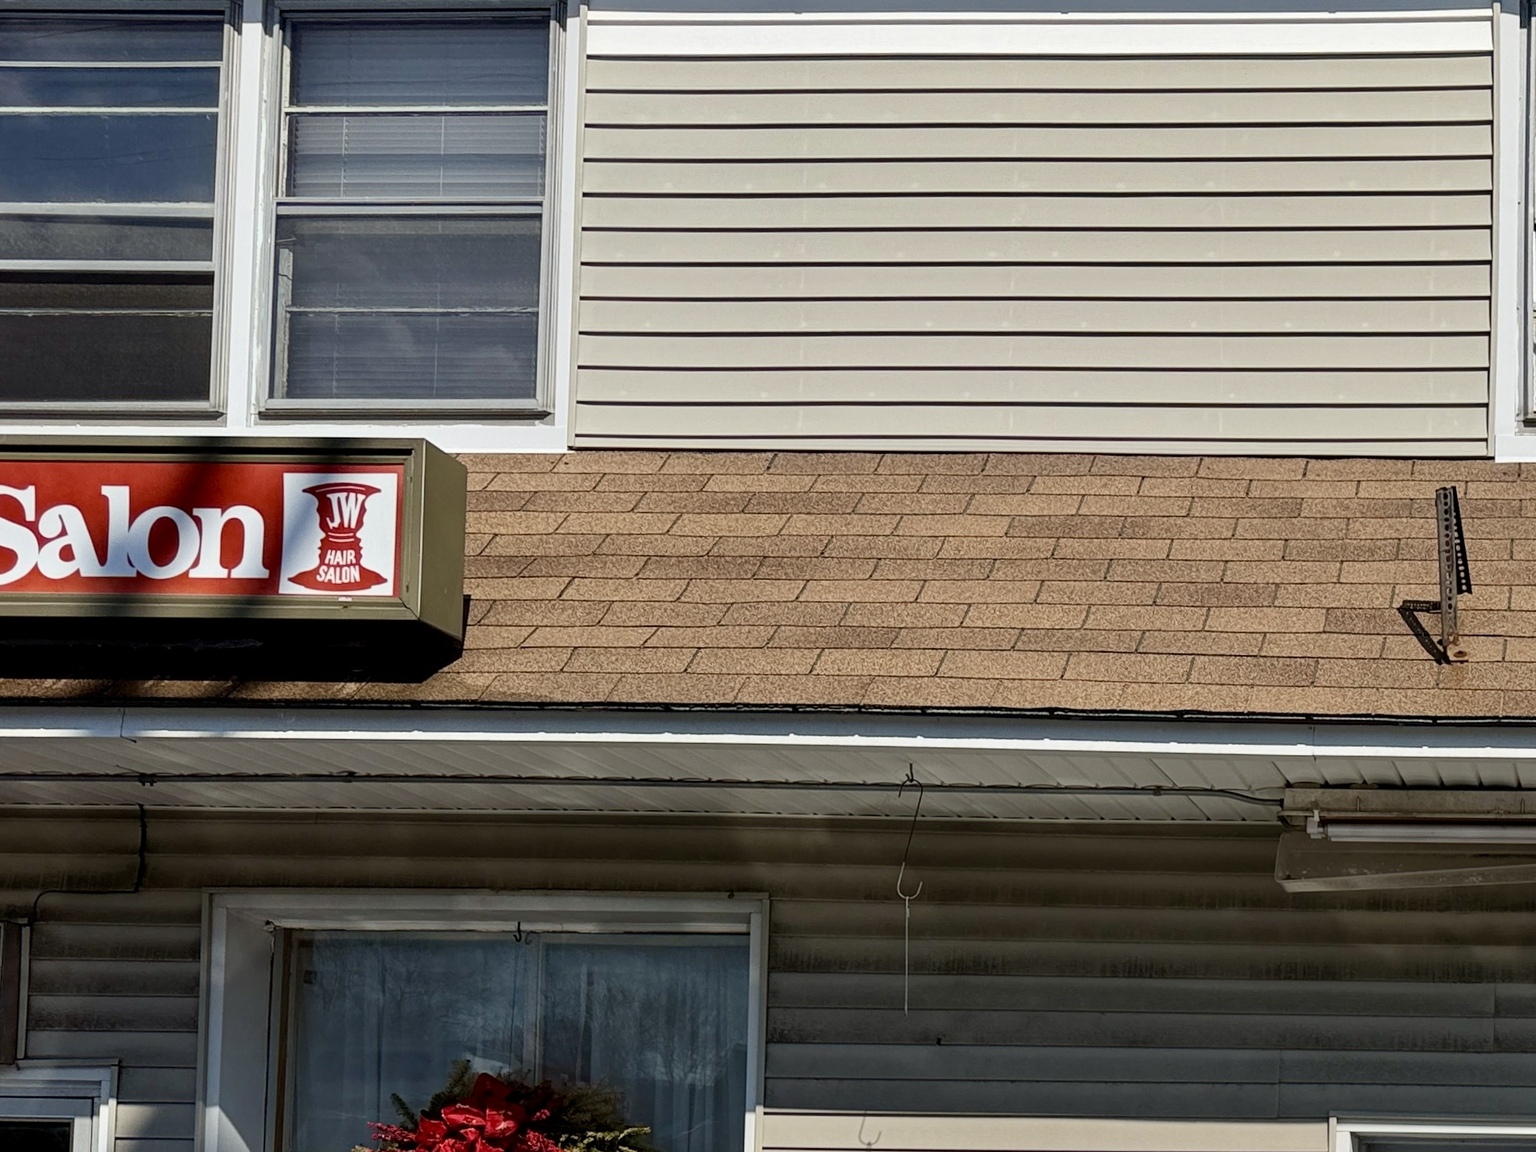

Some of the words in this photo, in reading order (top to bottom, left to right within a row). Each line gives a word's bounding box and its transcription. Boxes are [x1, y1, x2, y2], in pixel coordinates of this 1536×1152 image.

[325, 492, 367, 530] JW
[0, 484, 270, 586] Salon
[324, 549, 357, 566] HAIR
[315, 565, 361, 584] SALON
